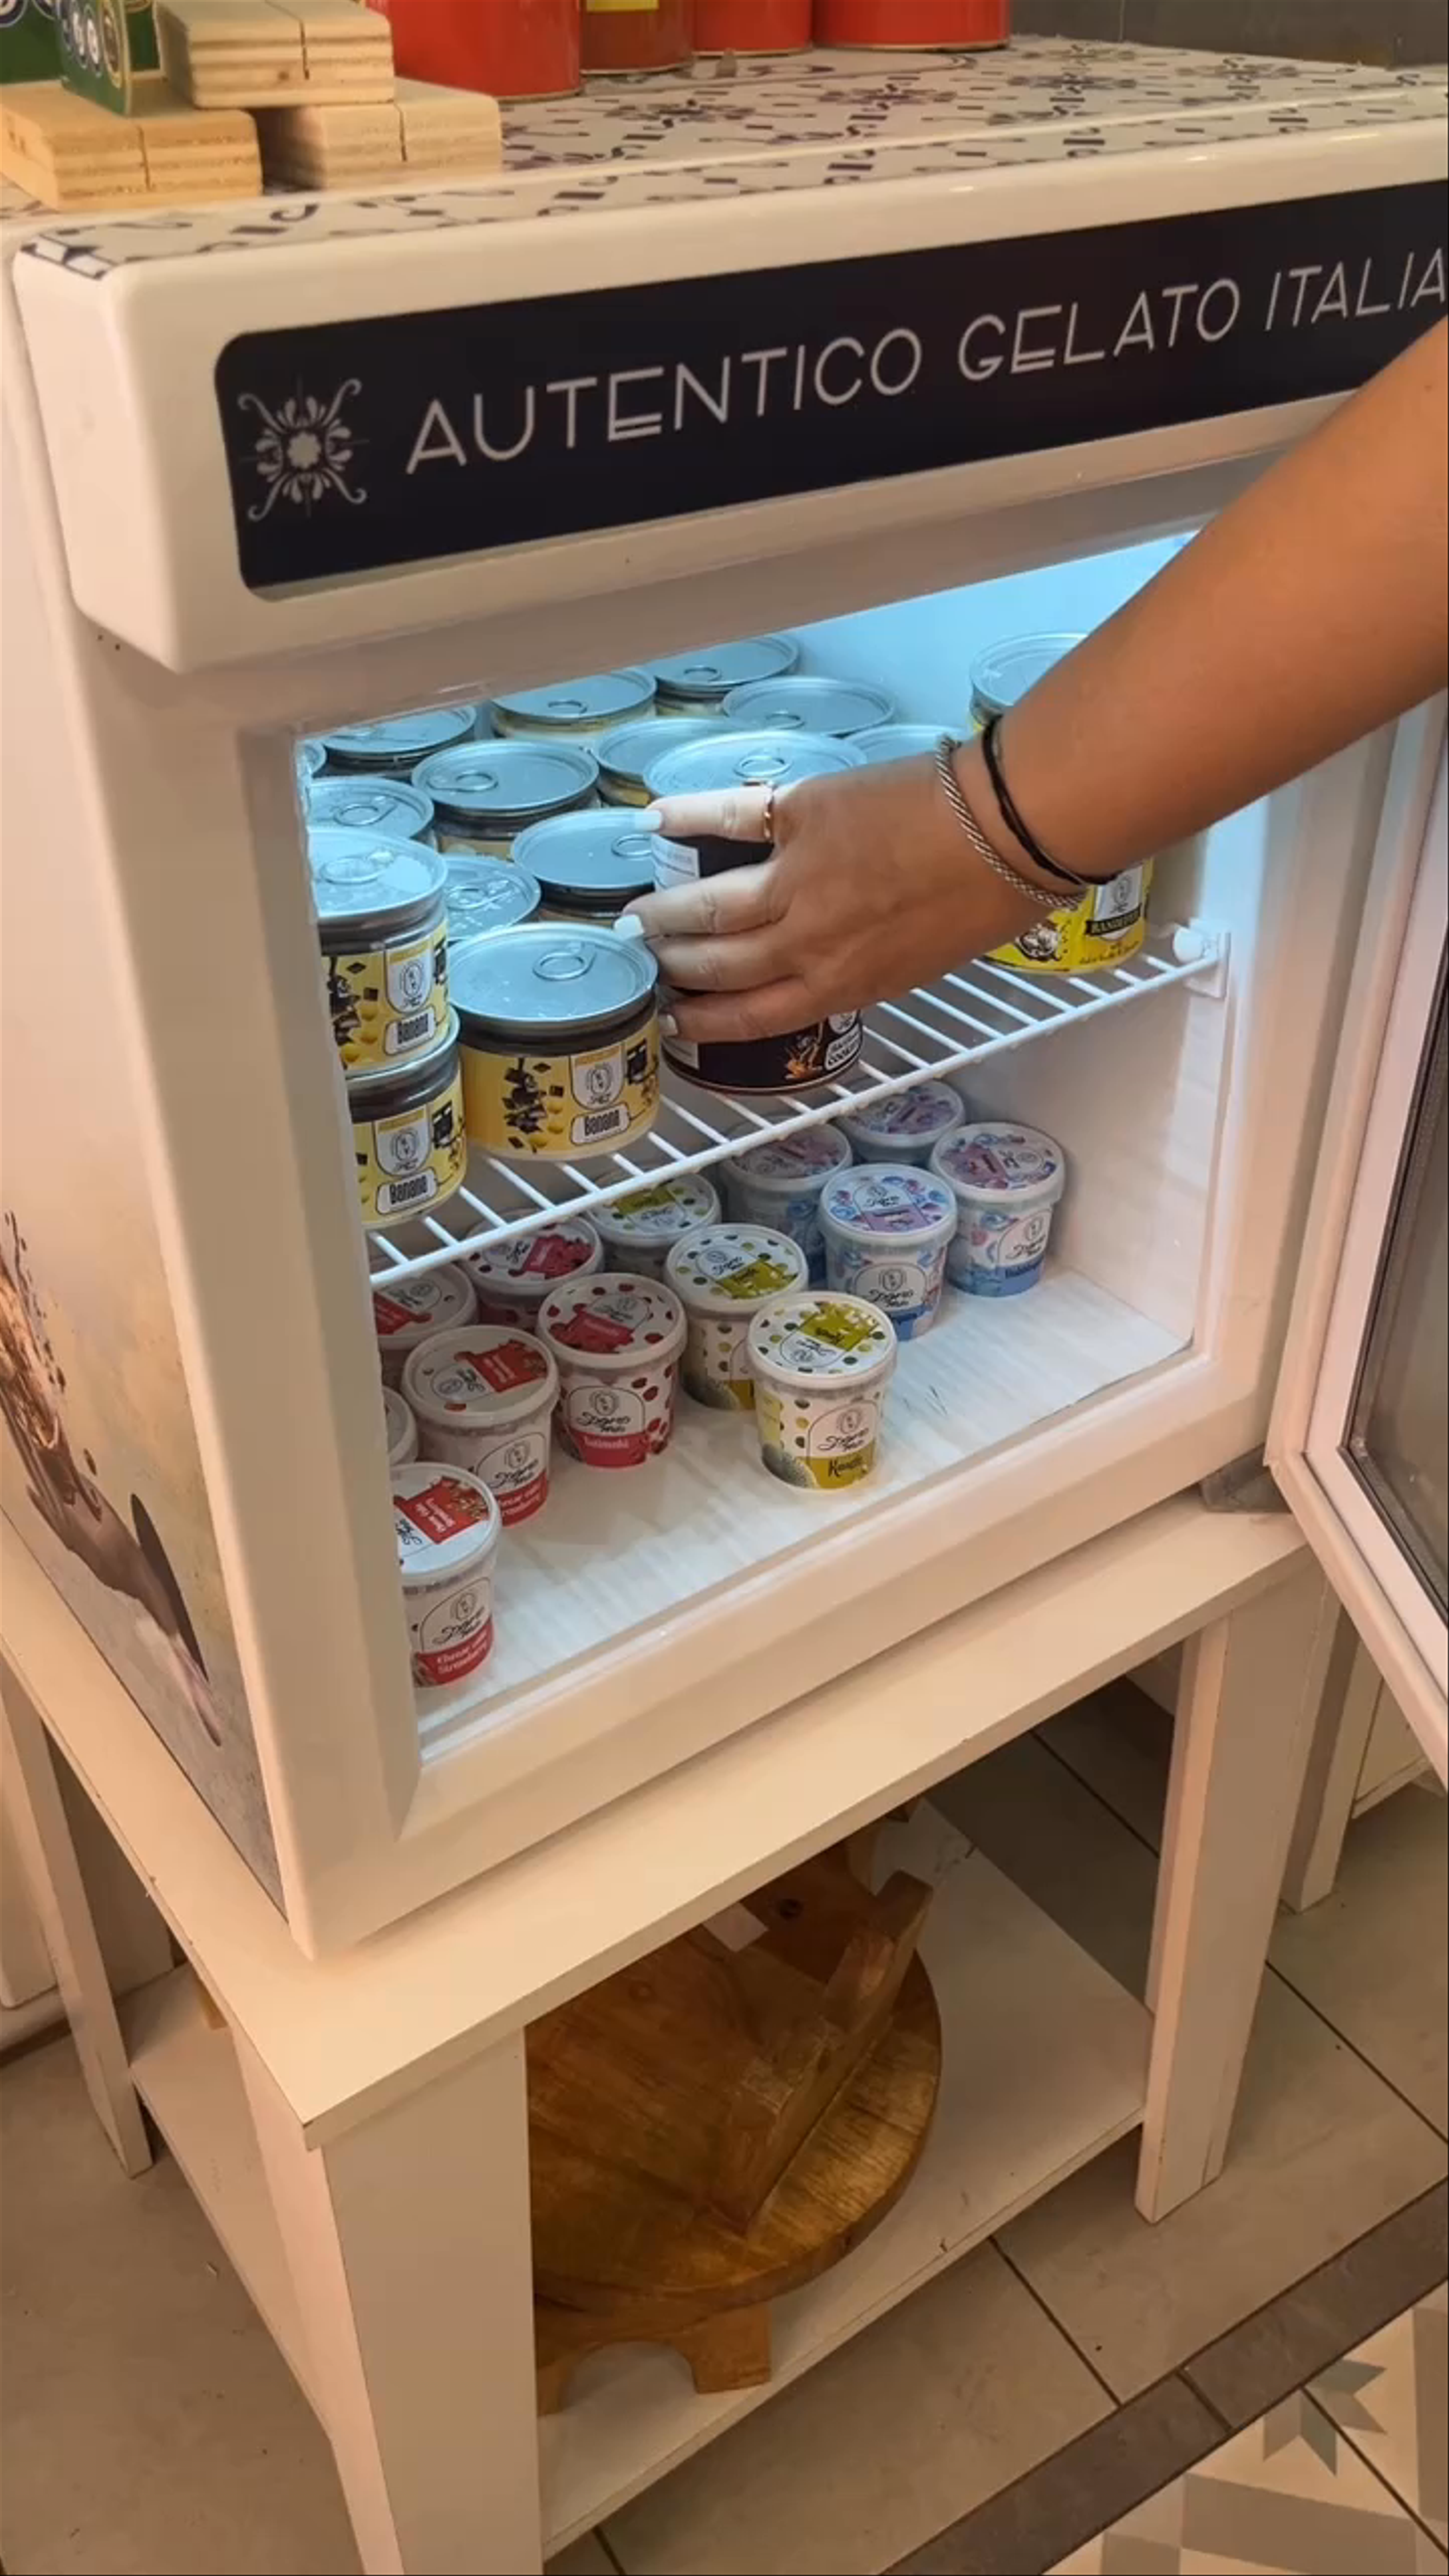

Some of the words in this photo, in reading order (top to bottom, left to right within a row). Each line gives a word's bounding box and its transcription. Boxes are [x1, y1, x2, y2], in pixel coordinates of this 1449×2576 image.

[407, 328, 921, 474] AUTENTICO
[958, 279, 1240, 380] GELATO
[1266, 248, 1446, 331] ITALIA
[584, 1109, 620, 1136] Banana
[389, 1175, 428, 1205] Banana
